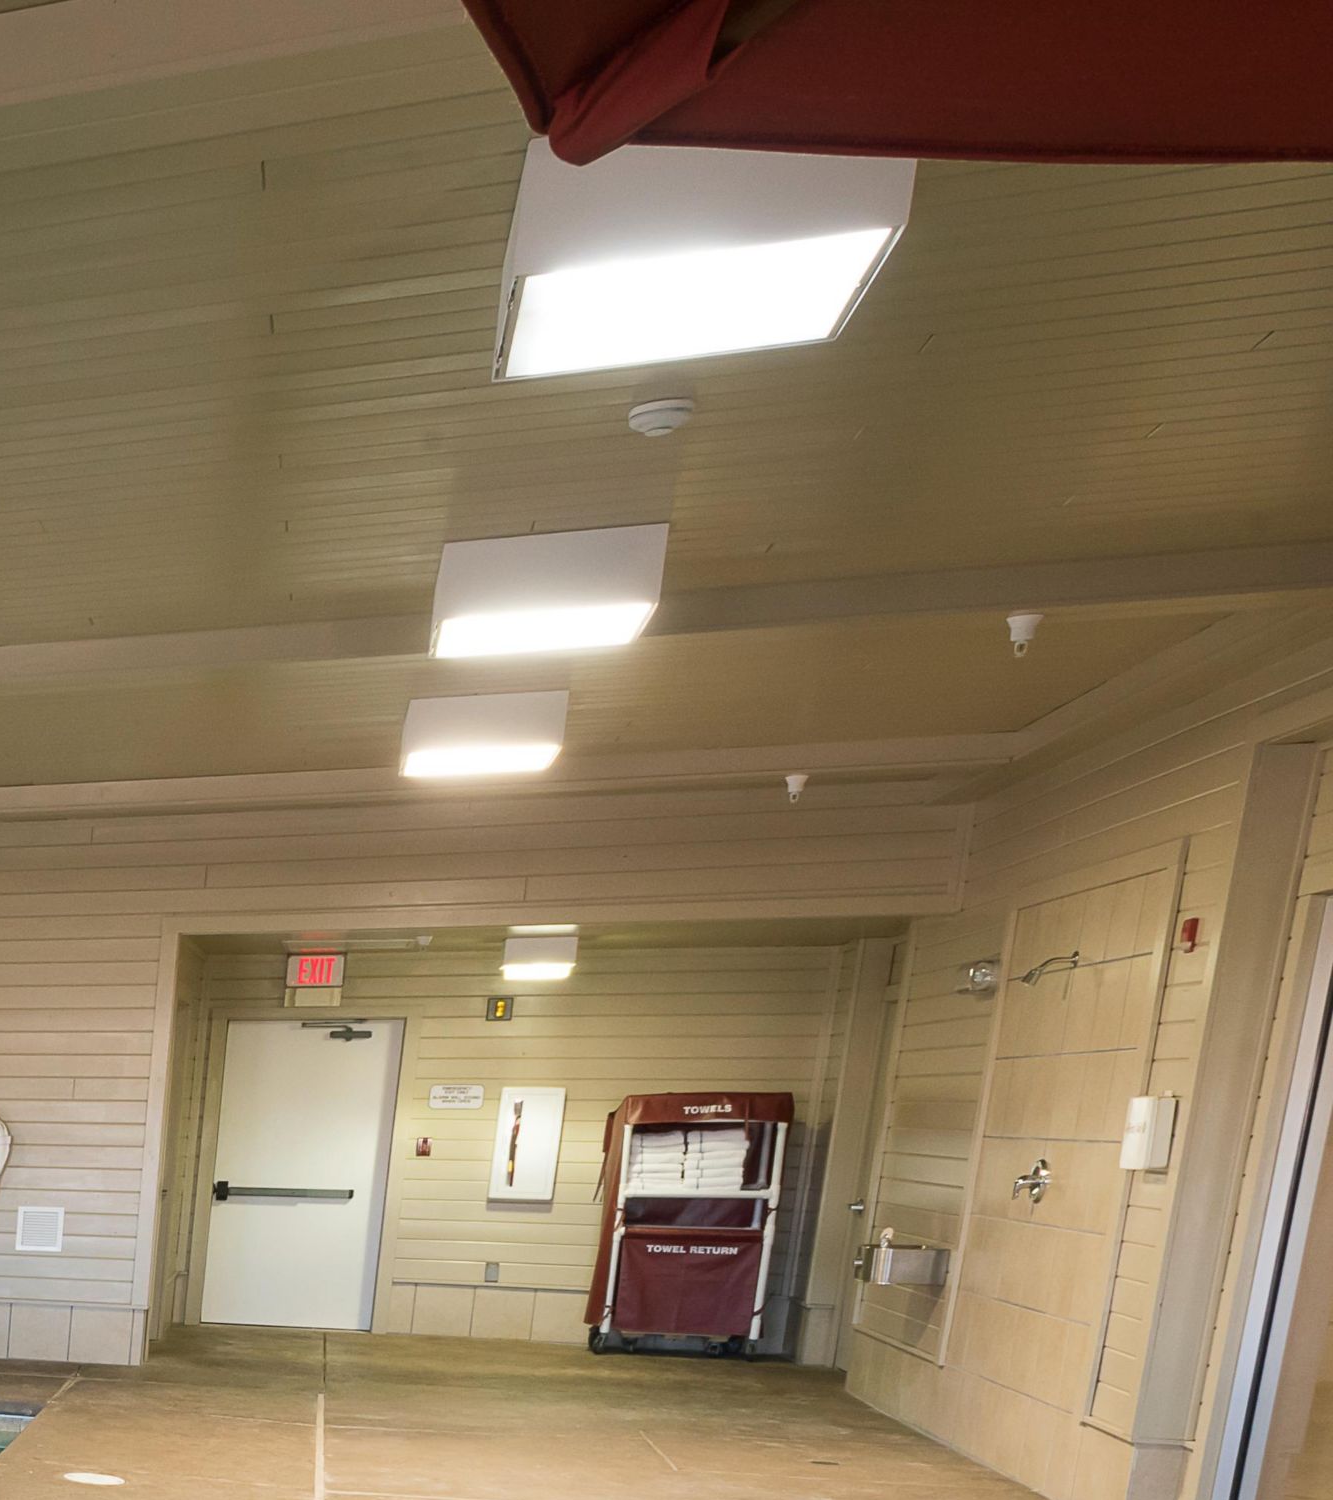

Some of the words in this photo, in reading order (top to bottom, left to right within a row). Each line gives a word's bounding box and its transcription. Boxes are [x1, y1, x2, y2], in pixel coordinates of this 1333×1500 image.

[298, 957, 335, 985] EXIT
[683, 1104, 733, 1115] TOWELS
[646, 1244, 687, 1254] TOWEL
[689, 1245, 738, 1255] RETURN
